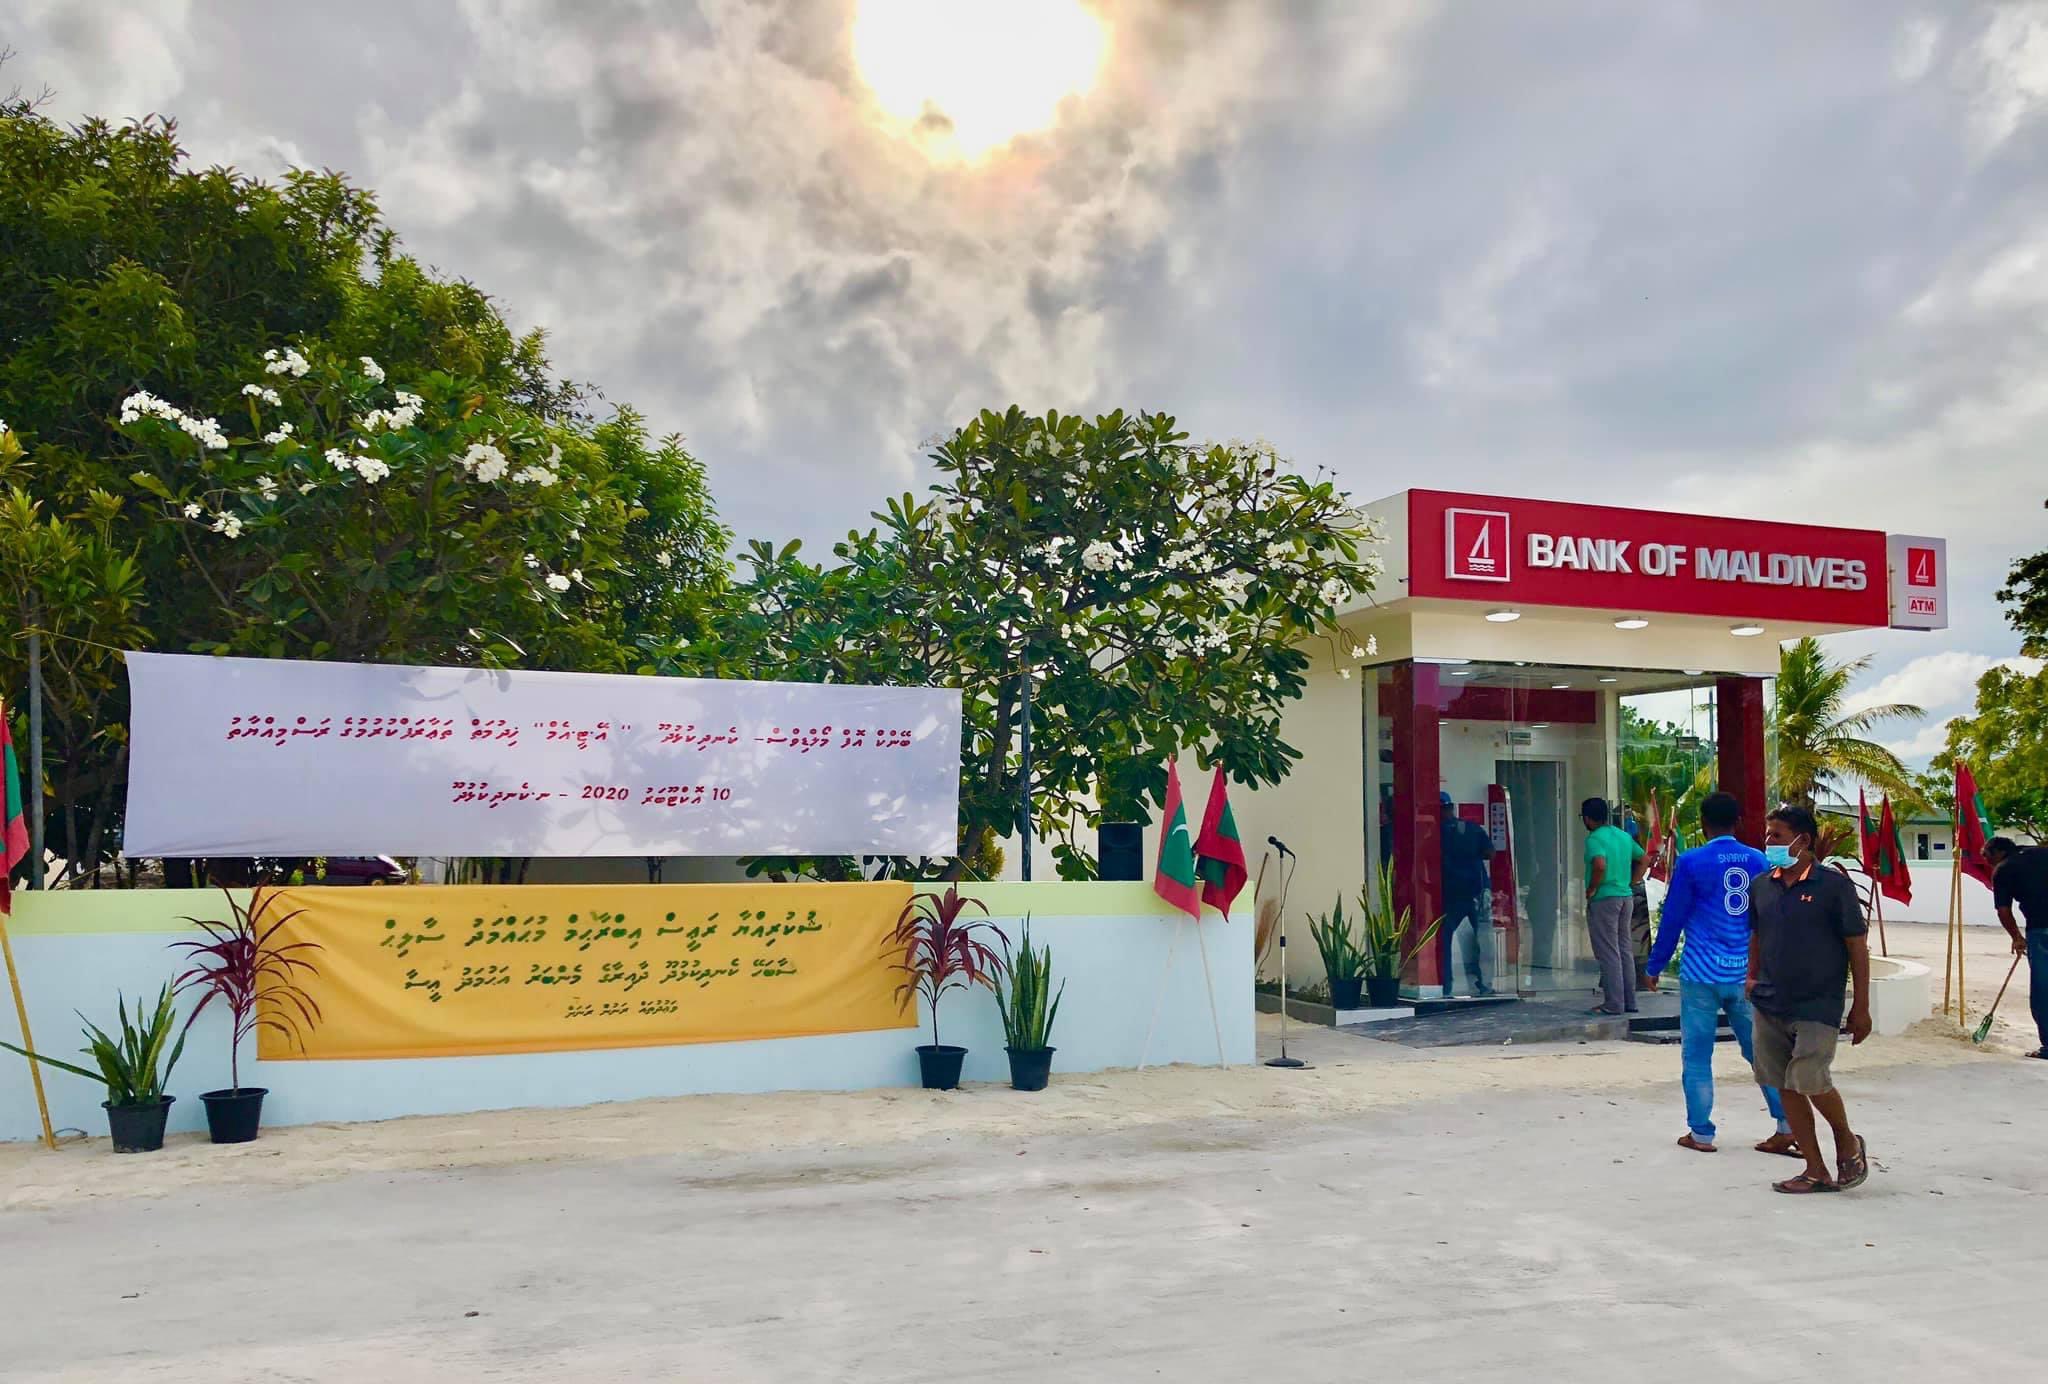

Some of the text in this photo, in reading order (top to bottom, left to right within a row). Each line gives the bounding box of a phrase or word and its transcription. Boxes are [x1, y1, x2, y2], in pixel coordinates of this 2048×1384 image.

[1527, 533, 1867, 590] BANK OF MALDIVES
[1910, 599, 1934, 612] ATM
[581, 784, 630, 801] 2020
[712, 787, 731, 801] 10
[1723, 867, 1750, 915] 8
